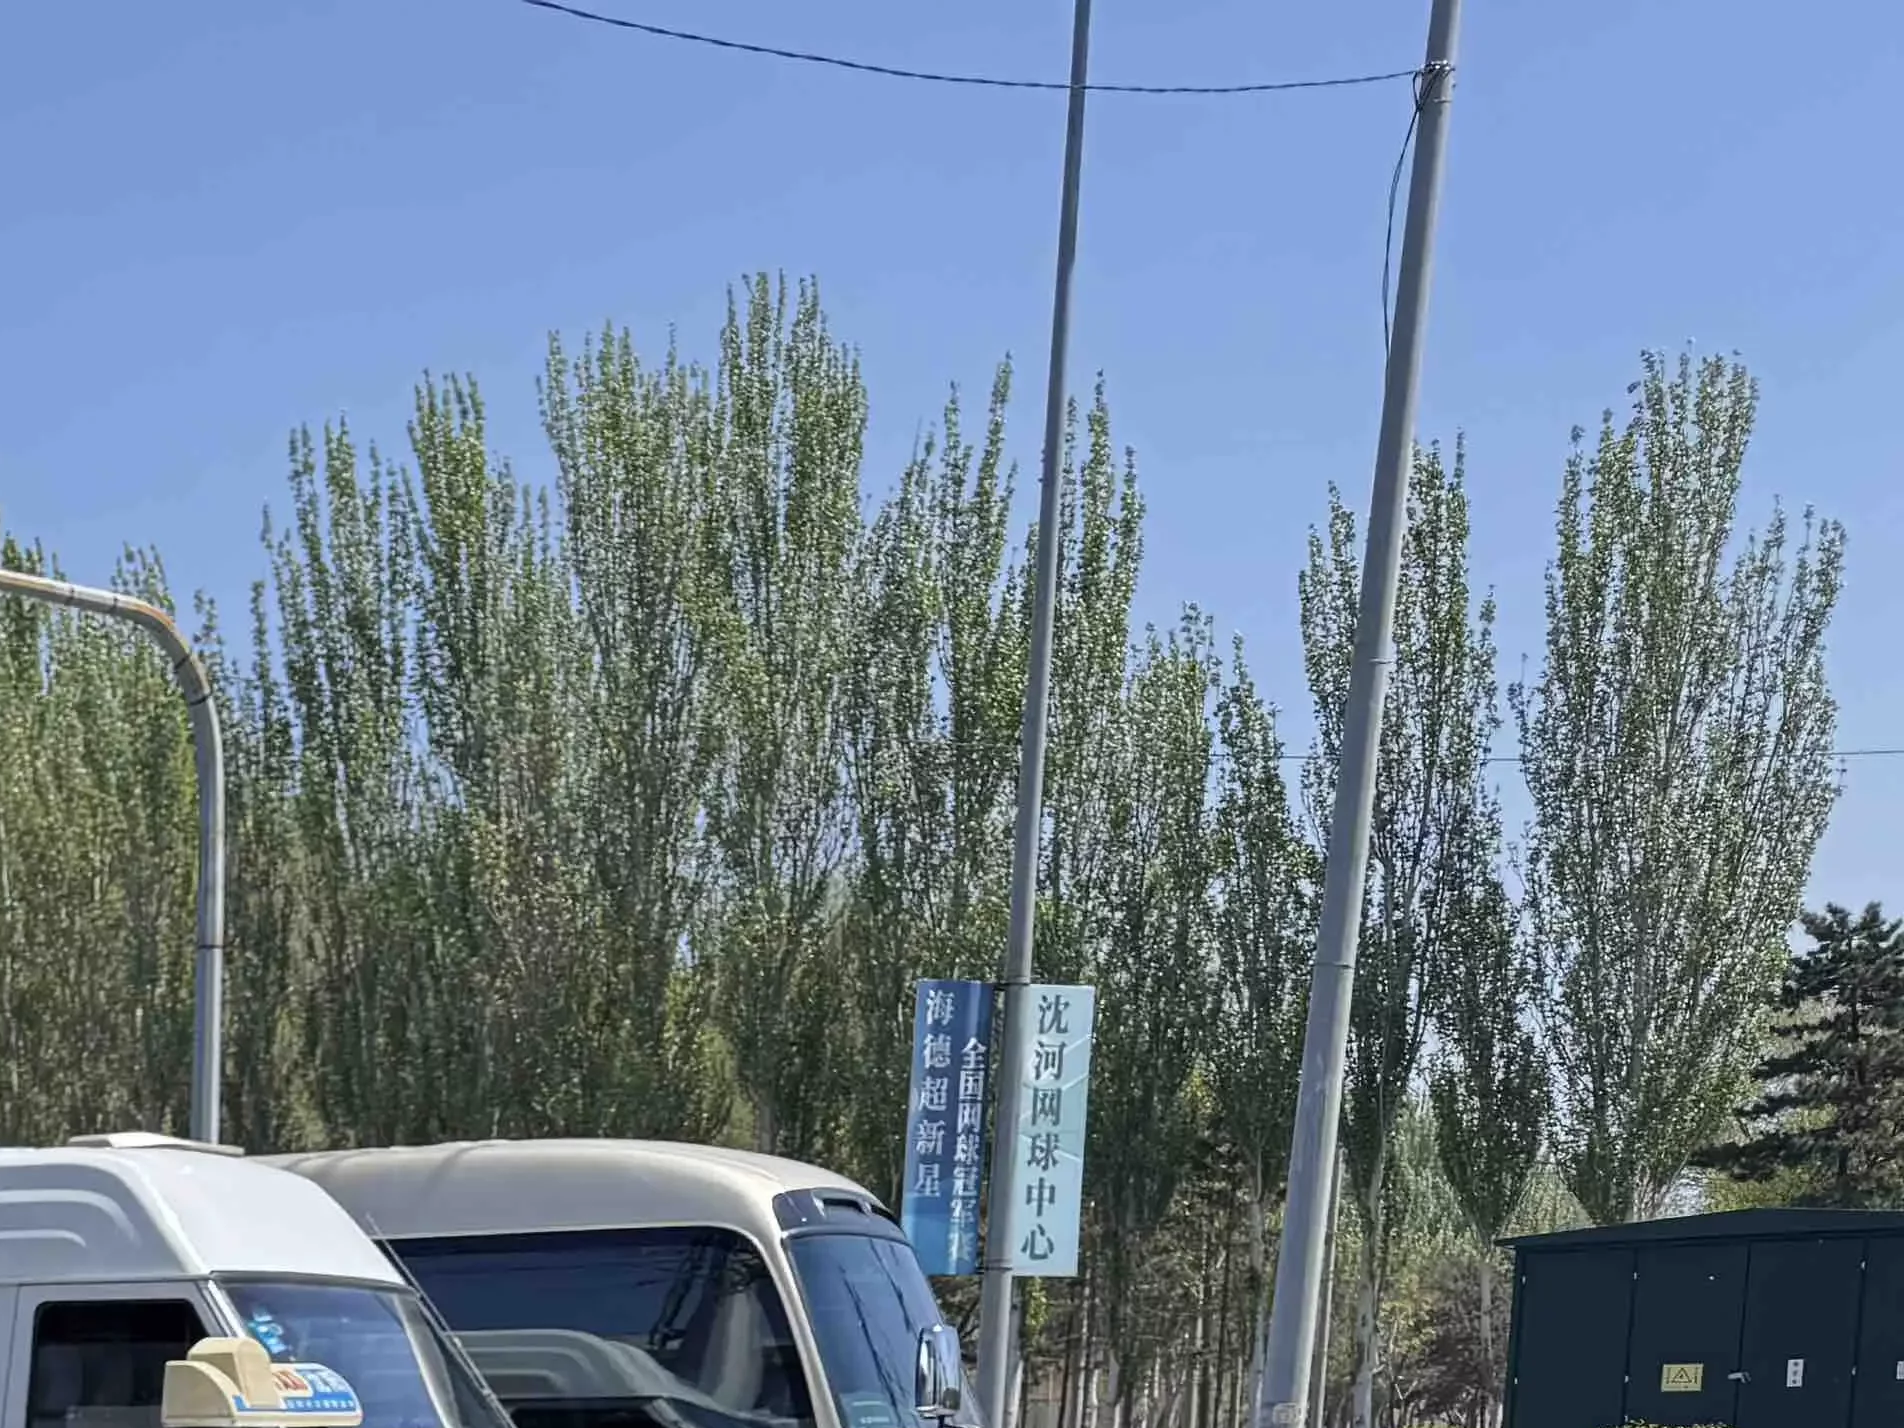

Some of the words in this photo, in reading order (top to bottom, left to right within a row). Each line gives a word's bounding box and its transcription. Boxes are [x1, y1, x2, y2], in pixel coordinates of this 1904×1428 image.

[914, 989, 955, 1198] 海德超新星
[1021, 994, 1072, 1262] 沈河网球中心
